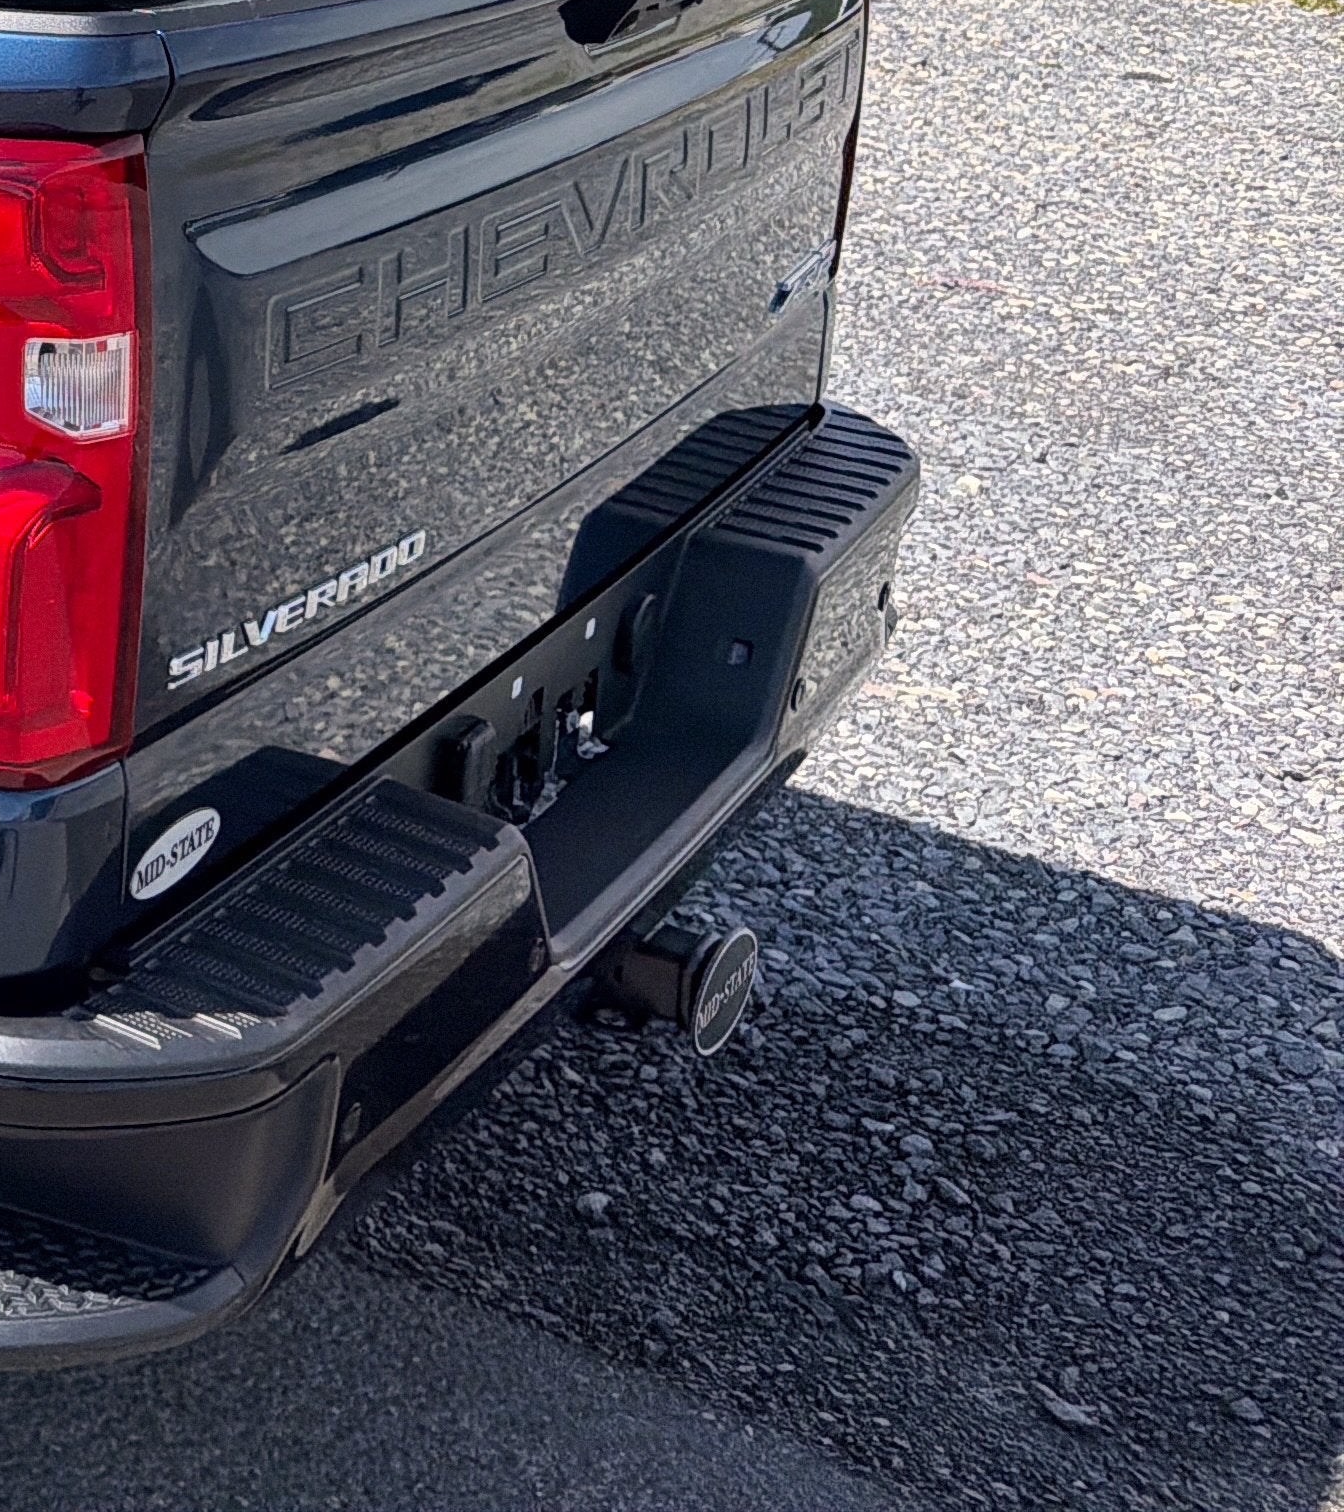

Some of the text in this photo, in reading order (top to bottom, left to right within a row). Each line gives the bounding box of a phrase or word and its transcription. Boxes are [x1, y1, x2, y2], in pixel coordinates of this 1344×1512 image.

[266, 30, 862, 392] CHEVROLET
[167, 529, 427, 690] SILVERADO
[134, 815, 216, 895] MID-STATE
